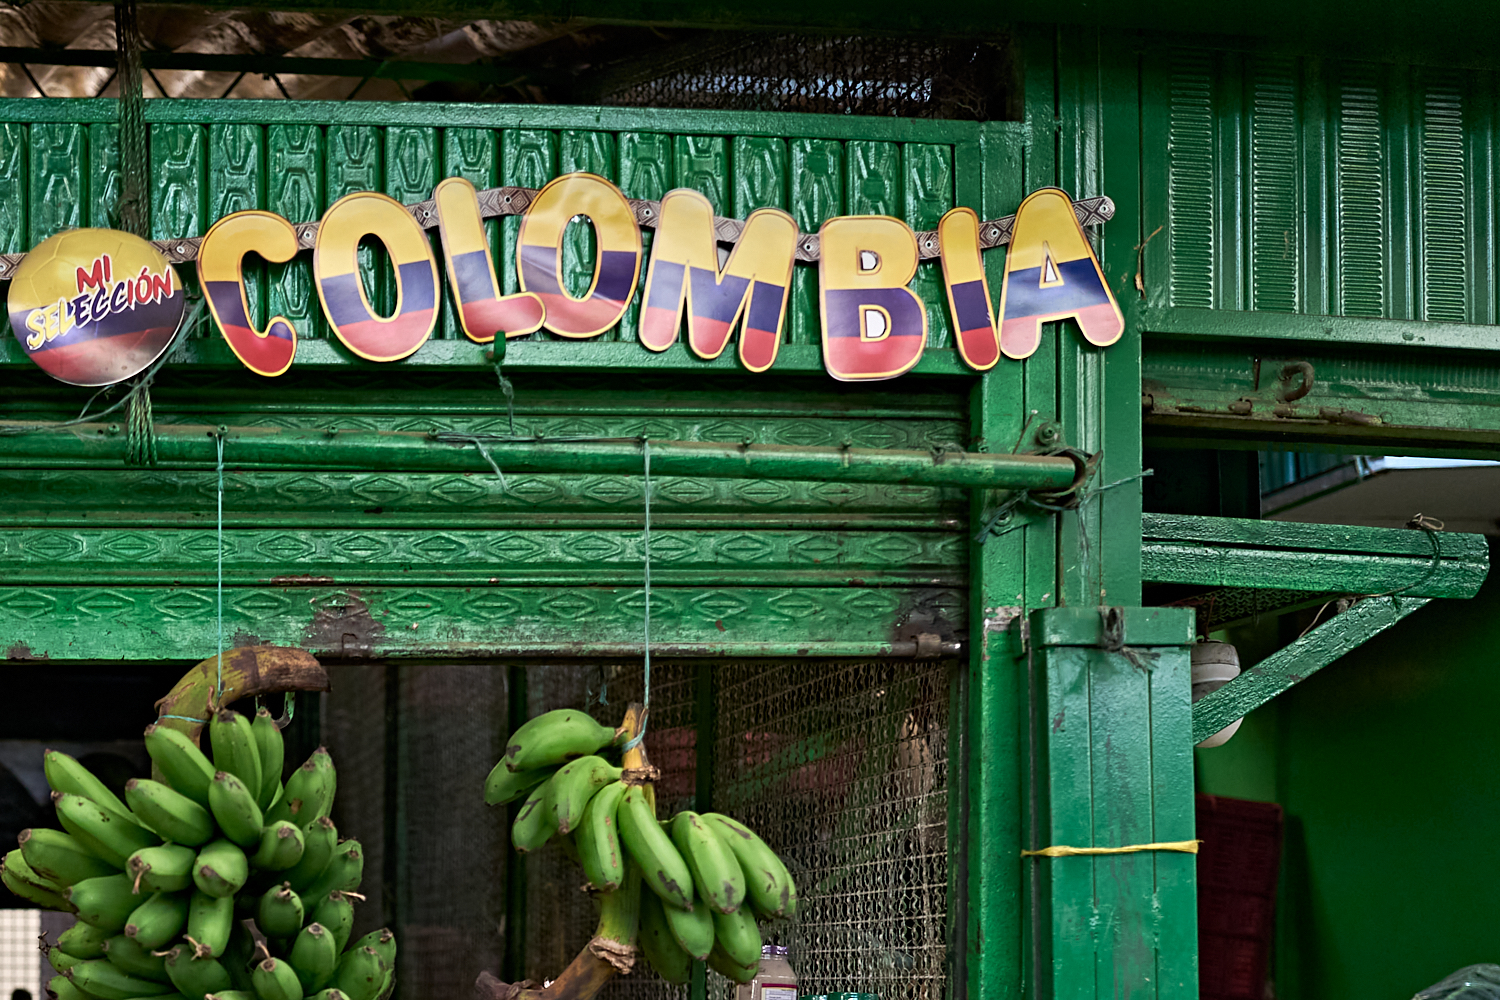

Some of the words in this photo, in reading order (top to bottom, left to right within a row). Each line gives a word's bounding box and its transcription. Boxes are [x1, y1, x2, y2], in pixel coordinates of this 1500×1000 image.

[25, 265, 174, 350] SELECCIÓN
[76, 253, 112, 294] MI
[197, 171, 1125, 382] COLOMBIA
